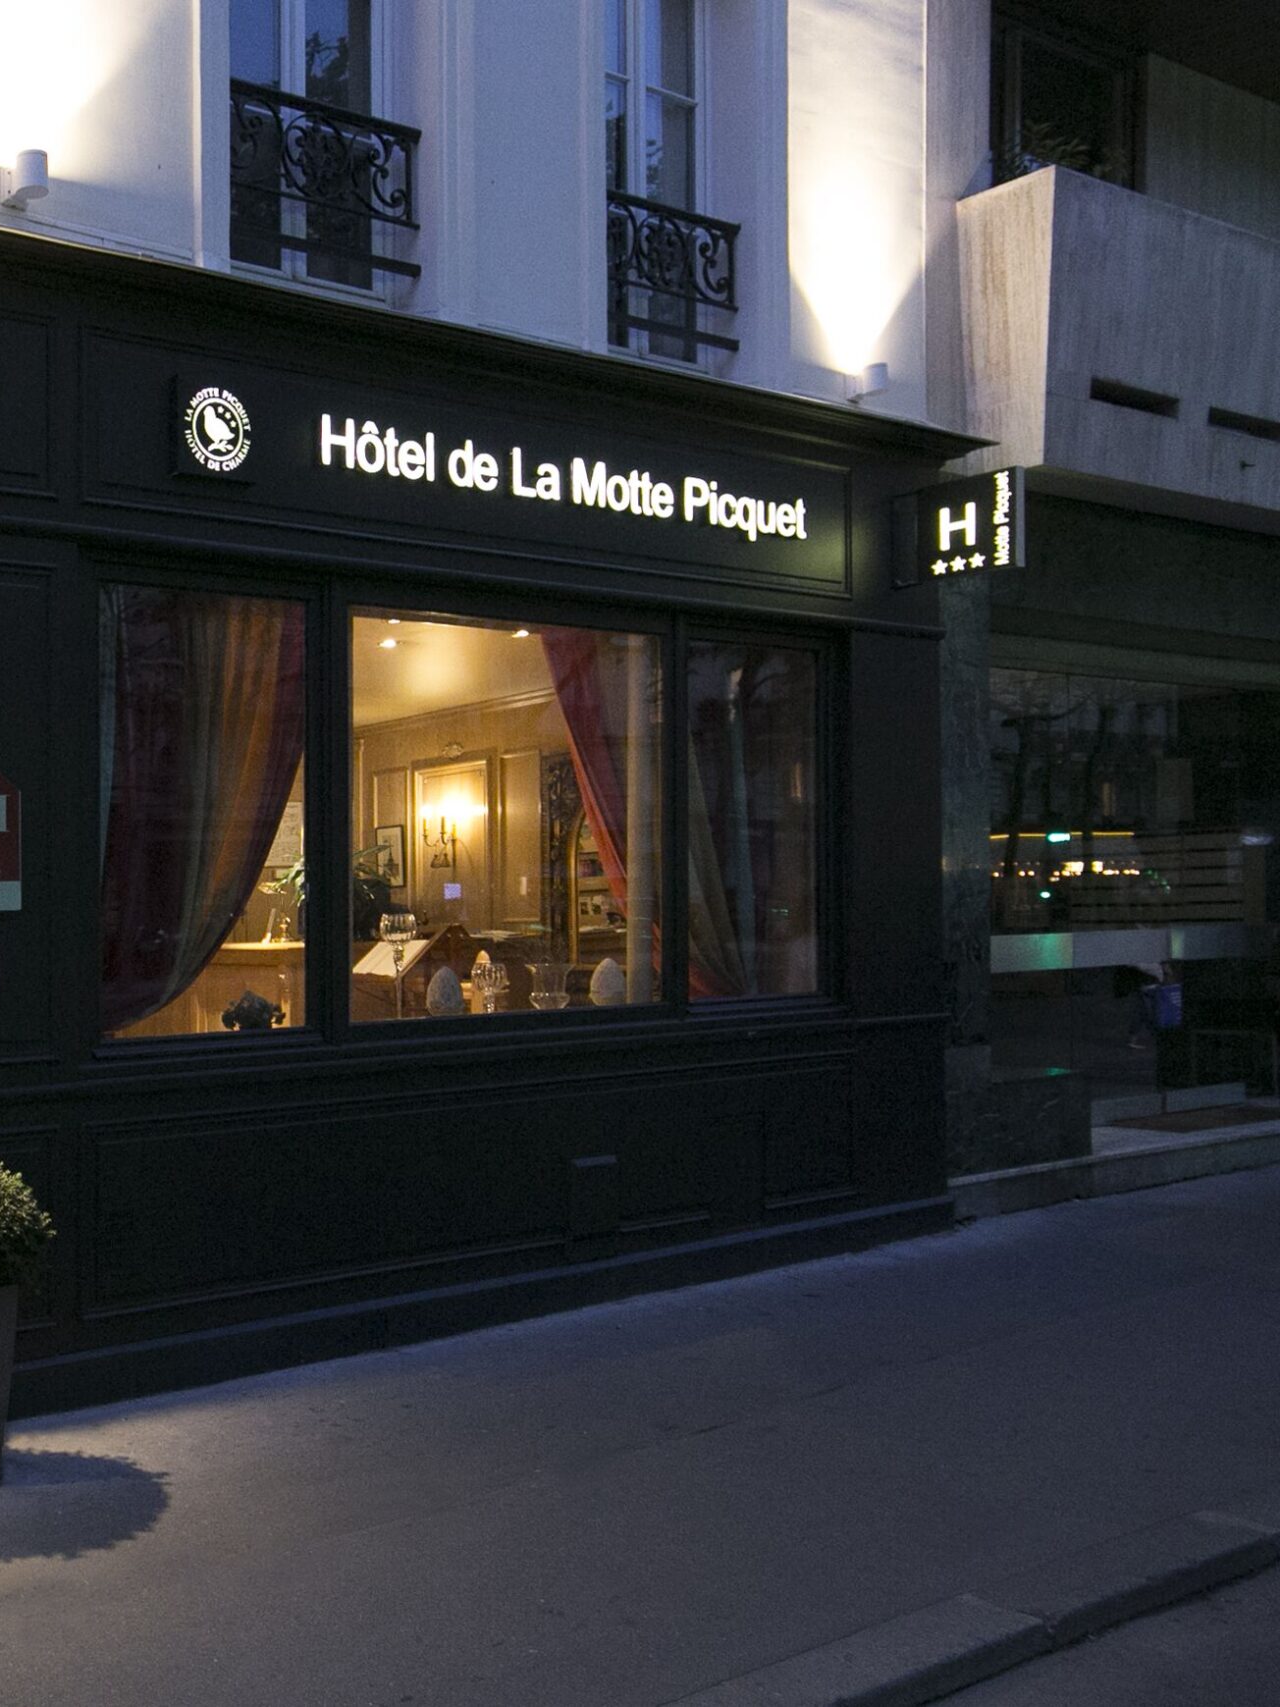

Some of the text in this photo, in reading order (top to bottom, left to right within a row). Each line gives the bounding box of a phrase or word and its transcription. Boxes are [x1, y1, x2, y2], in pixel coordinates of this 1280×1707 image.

[184, 387, 252, 432] LA MOTTE PICQUET
[207, 460, 221, 472] DE
[221, 438, 252, 472] CHARME
[321, 413, 808, 542] Hôtel de La Motte Picquet
[938, 501, 977, 551] H
[993, 470, 1012, 566] Motte Picquet
